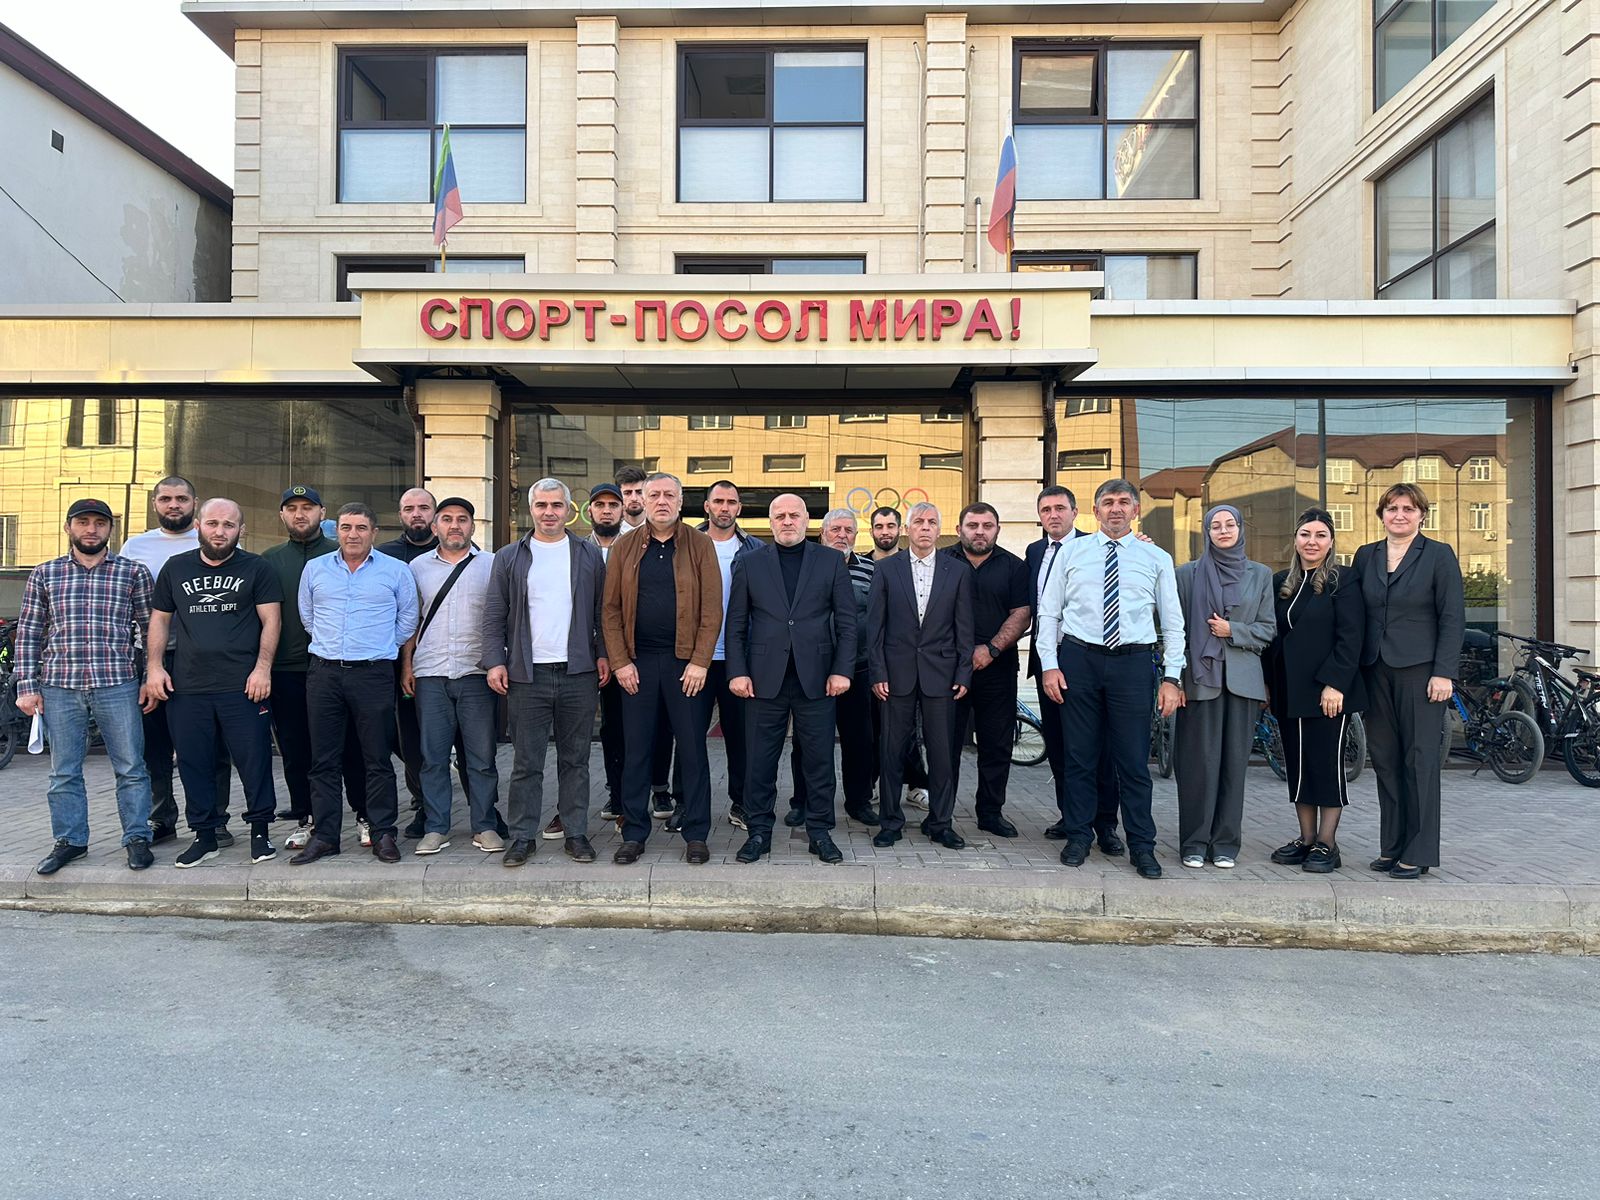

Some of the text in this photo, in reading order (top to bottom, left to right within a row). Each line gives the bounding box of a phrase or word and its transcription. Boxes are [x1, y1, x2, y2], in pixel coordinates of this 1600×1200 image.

[849, 298, 1022, 341] МИРА!
[181, 575, 245, 596] REEBOK
[189, 604, 218, 614] ATHLETIC
